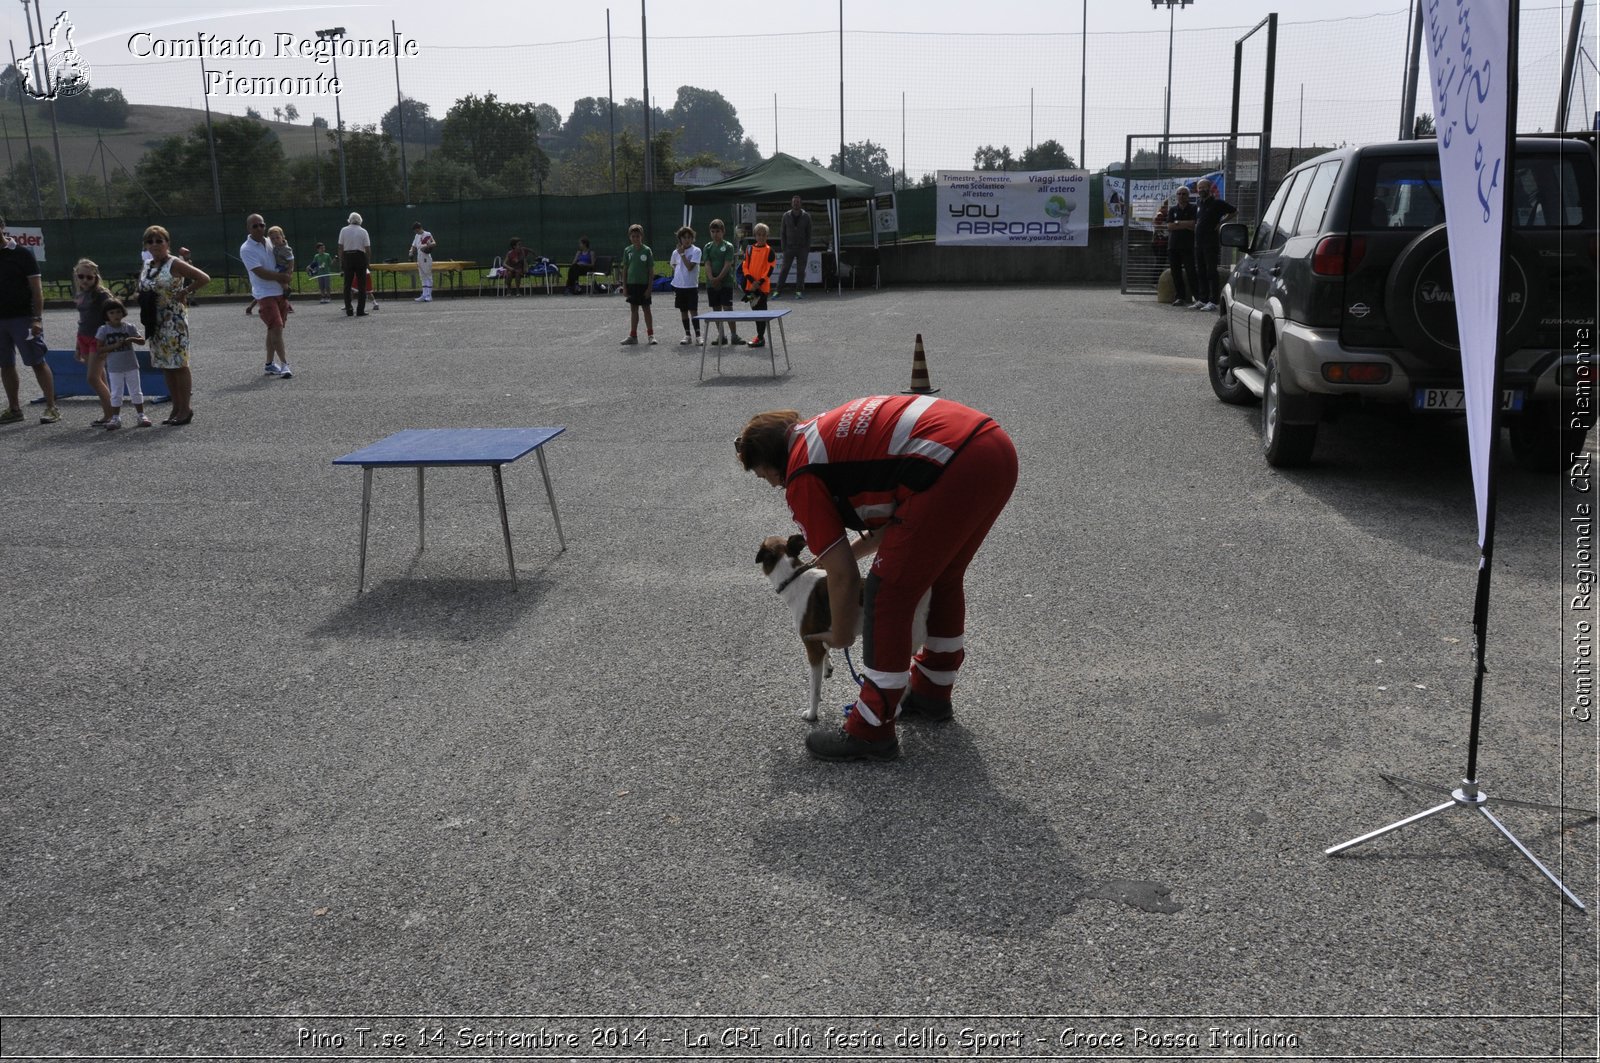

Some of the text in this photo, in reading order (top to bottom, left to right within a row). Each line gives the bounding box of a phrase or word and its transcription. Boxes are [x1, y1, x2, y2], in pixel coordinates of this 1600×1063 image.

[944, 175, 978, 183] Trimestre,
[1029, 176, 1056, 184] Viaggi
[949, 204, 1000, 218] YOU
[956, 222, 1060, 234] ABROAD
[836, 411, 856, 438] CROCE
